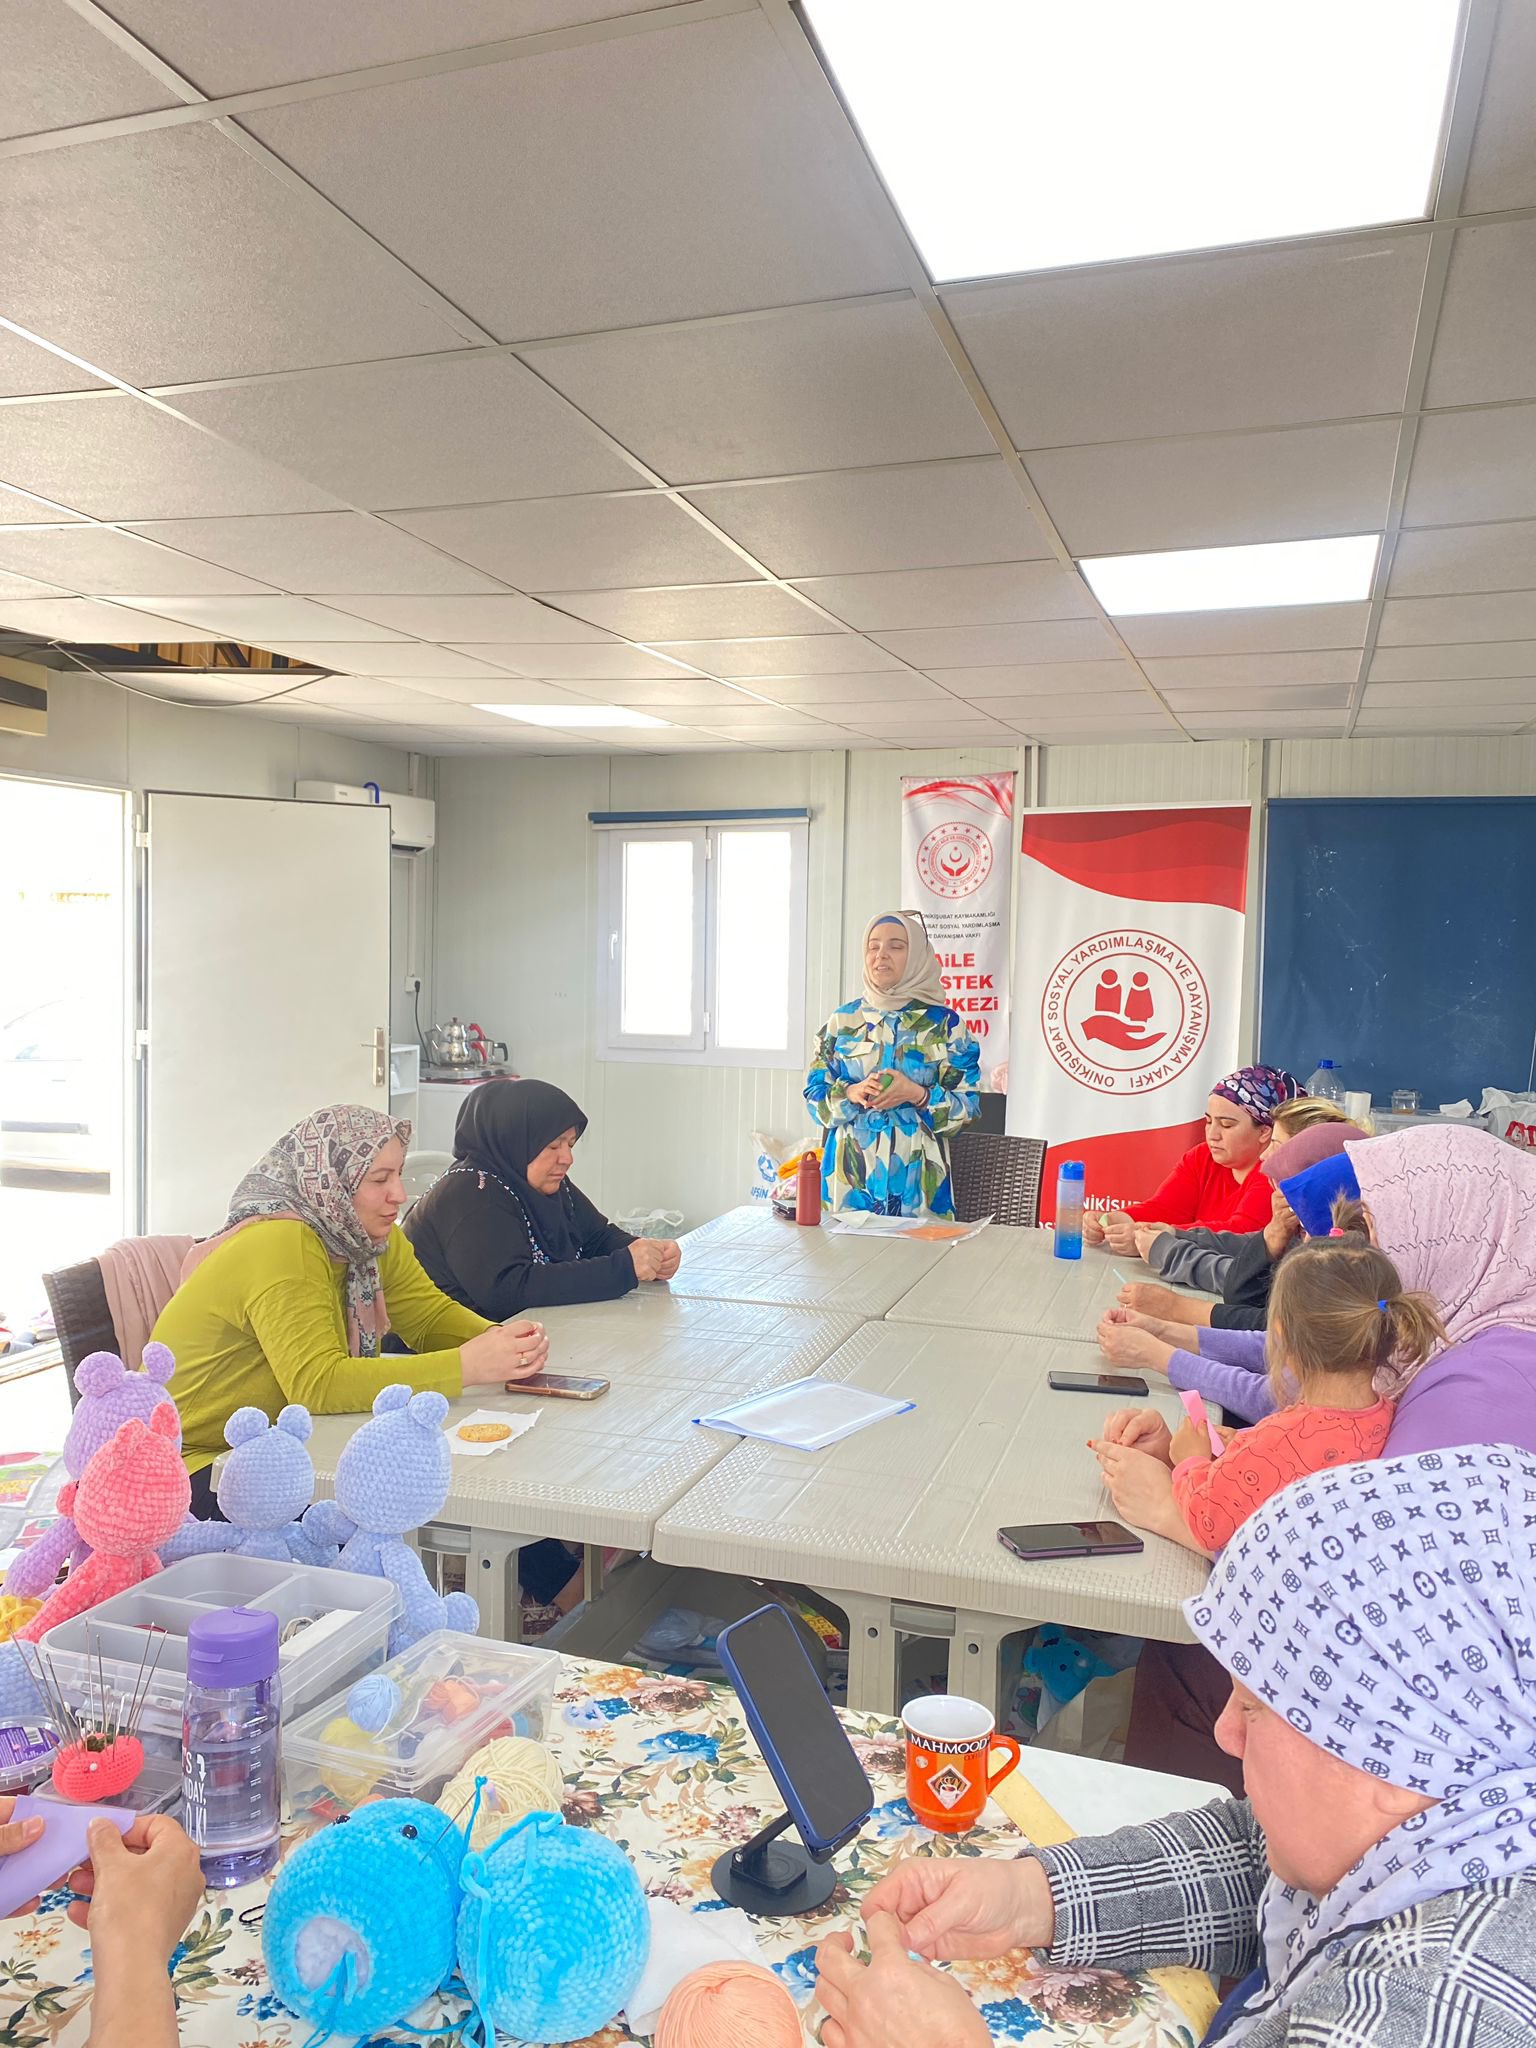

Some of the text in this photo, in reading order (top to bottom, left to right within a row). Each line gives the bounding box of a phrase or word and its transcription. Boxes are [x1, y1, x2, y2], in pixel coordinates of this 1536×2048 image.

[954, 911, 996, 919] KAYMAKAMLIĞI
[940, 975, 993, 989] STEK
[1048, 936, 1203, 1088] ONİKİŞUBAT SOSYAL YARDIMLAŞMA VE DAYANIŞMA VAKFI
